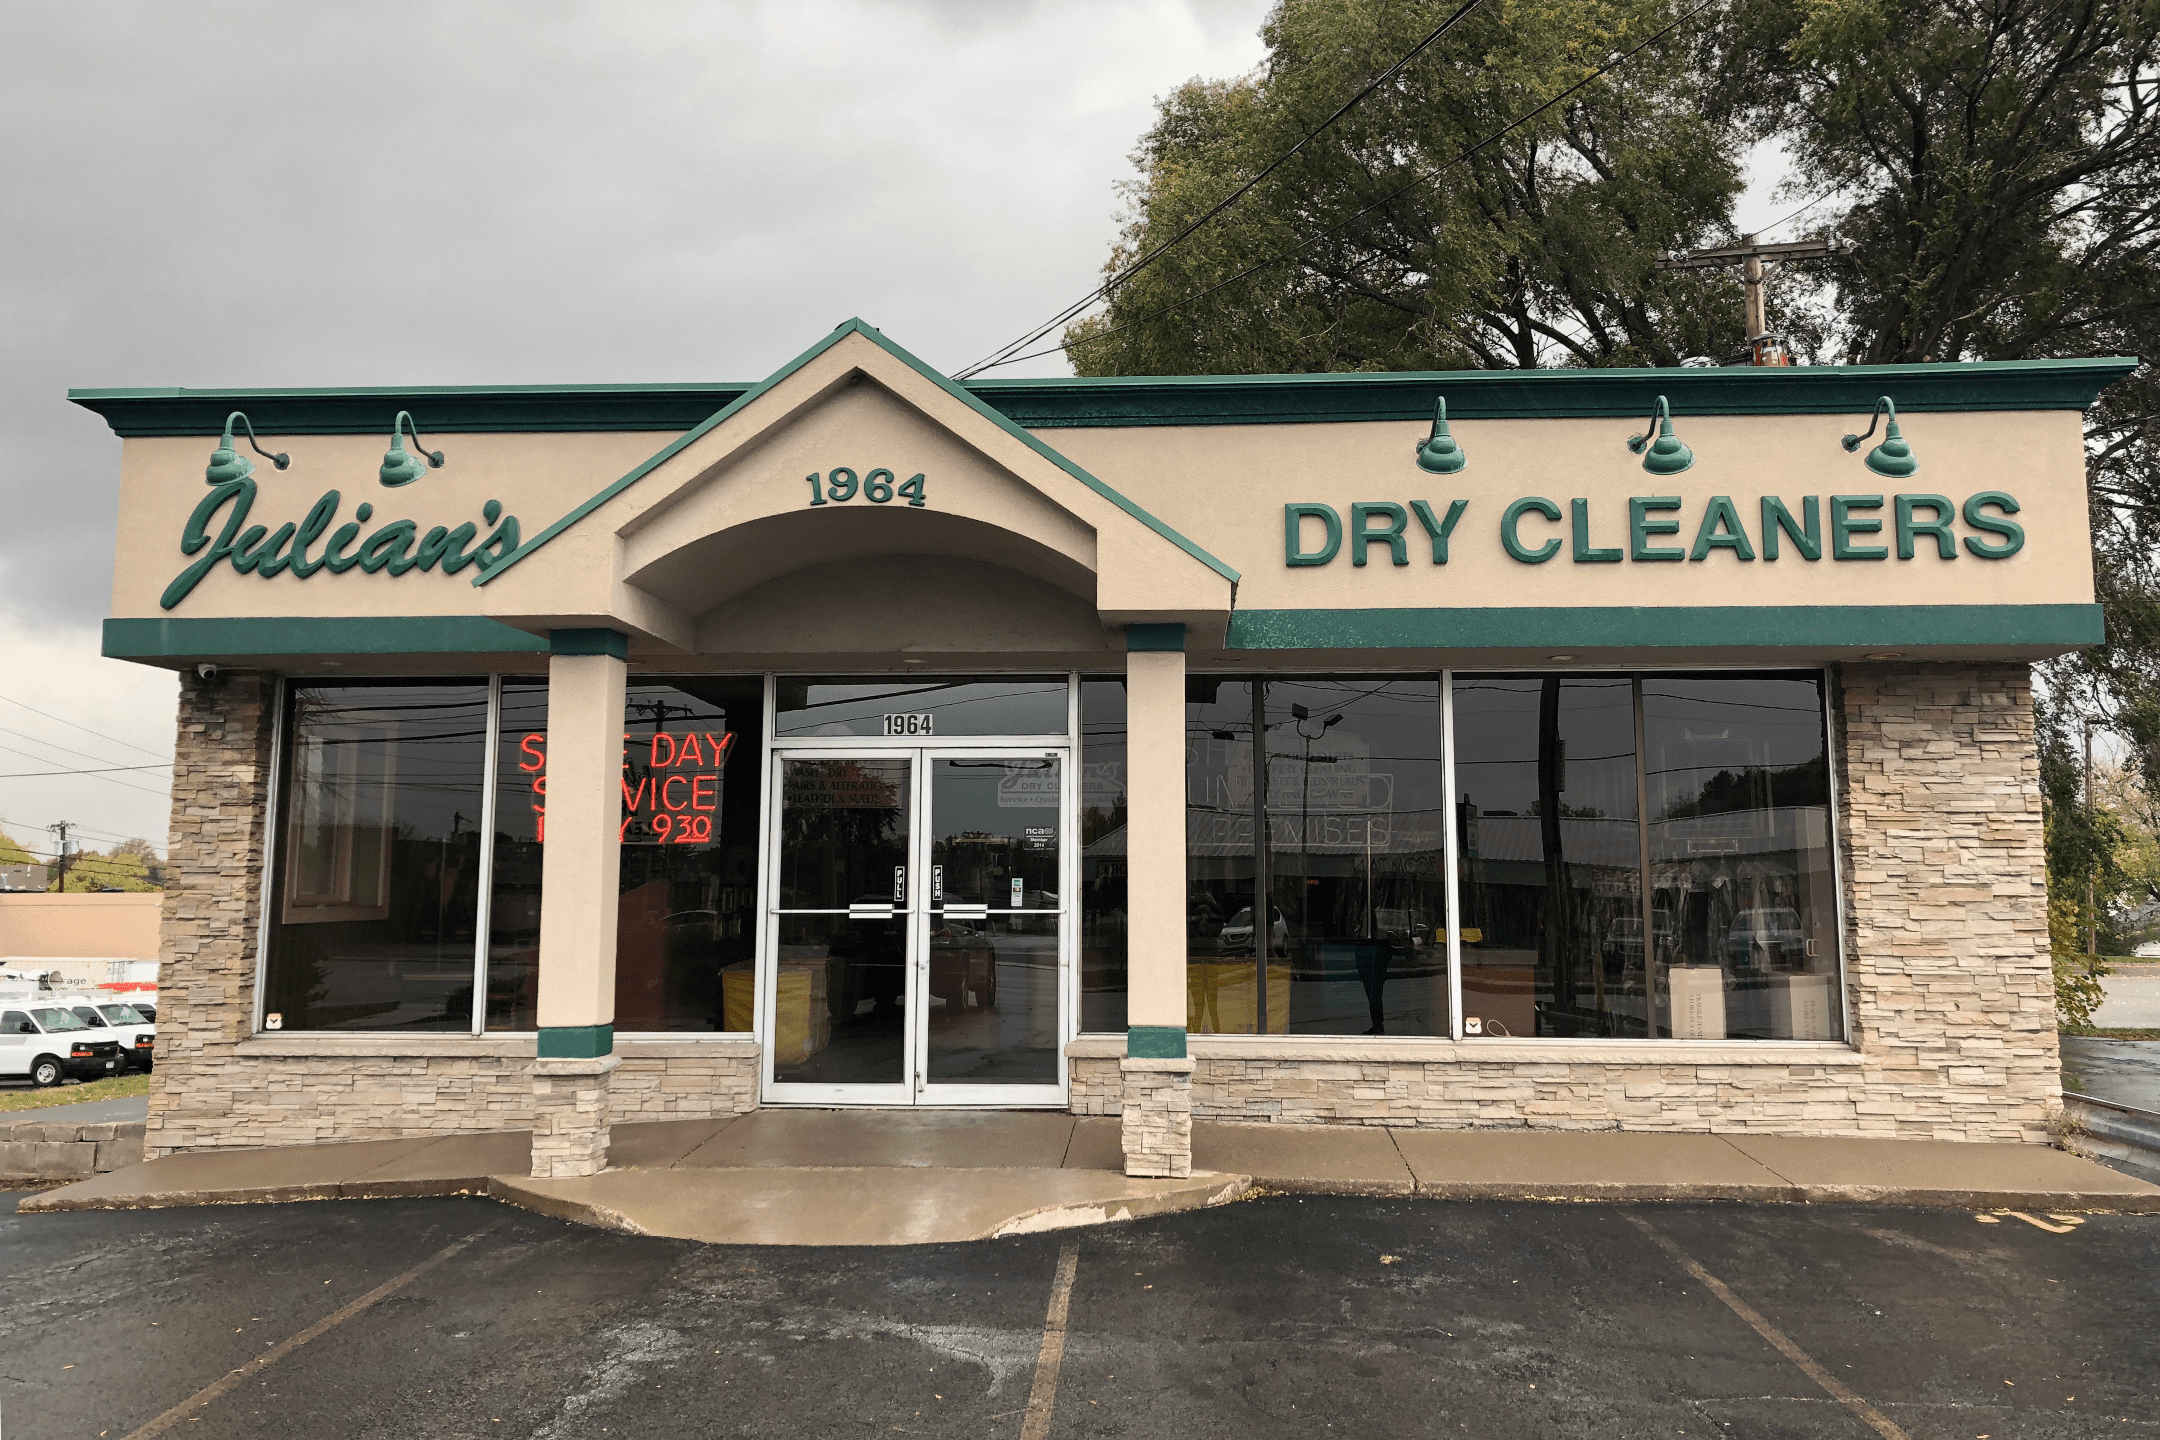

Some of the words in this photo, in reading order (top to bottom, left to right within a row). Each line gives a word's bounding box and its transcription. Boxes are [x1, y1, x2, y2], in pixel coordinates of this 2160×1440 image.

[806, 467, 926, 507] 1964
[160, 477, 520, 610] Julian's
[1285, 500, 1469, 566] DRY
[1500, 491, 2025, 564] CLEANERS
[884, 715, 932, 735] 1964
[650, 733, 732, 767] DAY
[532, 775, 717, 812] SVICE
[1000, 796, 1028, 804] Service
[1021, 782, 1042, 790] DRY
[1046, 782, 1104, 790] CLERS
